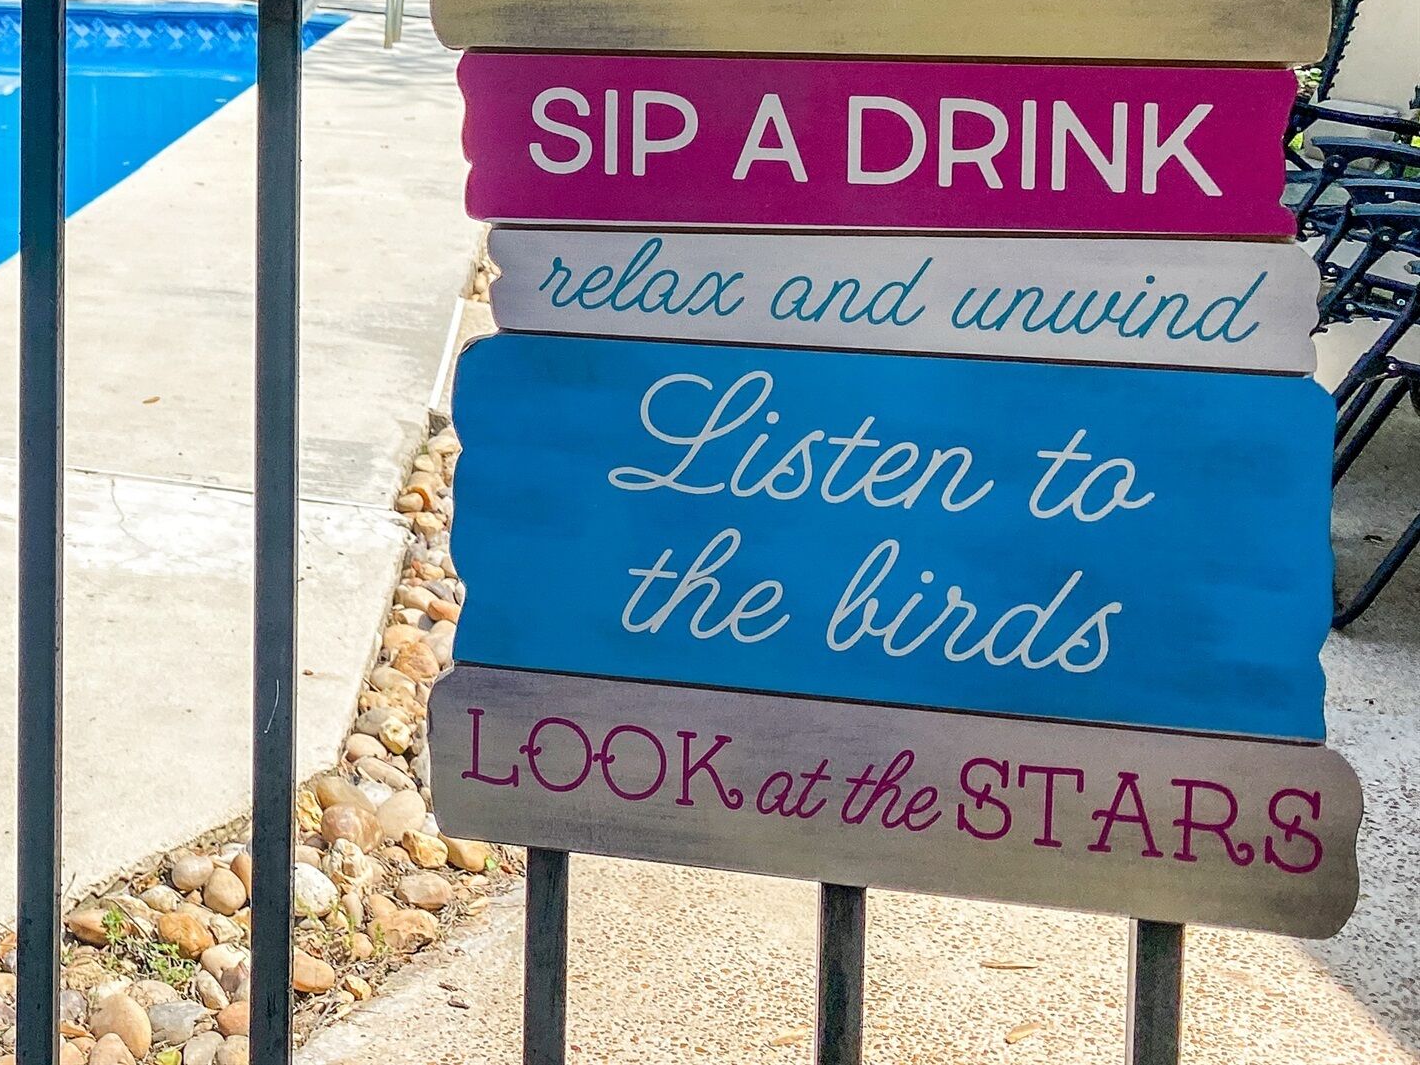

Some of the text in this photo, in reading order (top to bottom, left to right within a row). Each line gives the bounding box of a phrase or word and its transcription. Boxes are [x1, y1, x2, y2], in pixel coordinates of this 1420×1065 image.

[529, 87, 1223, 198] SIP A DRINK
[538, 237, 1268, 344] relax and unwind
[608, 370, 1155, 522] Listen to
[619, 527, 1123, 674] the birds
[461, 708, 1323, 875] LOOK at the STARS
